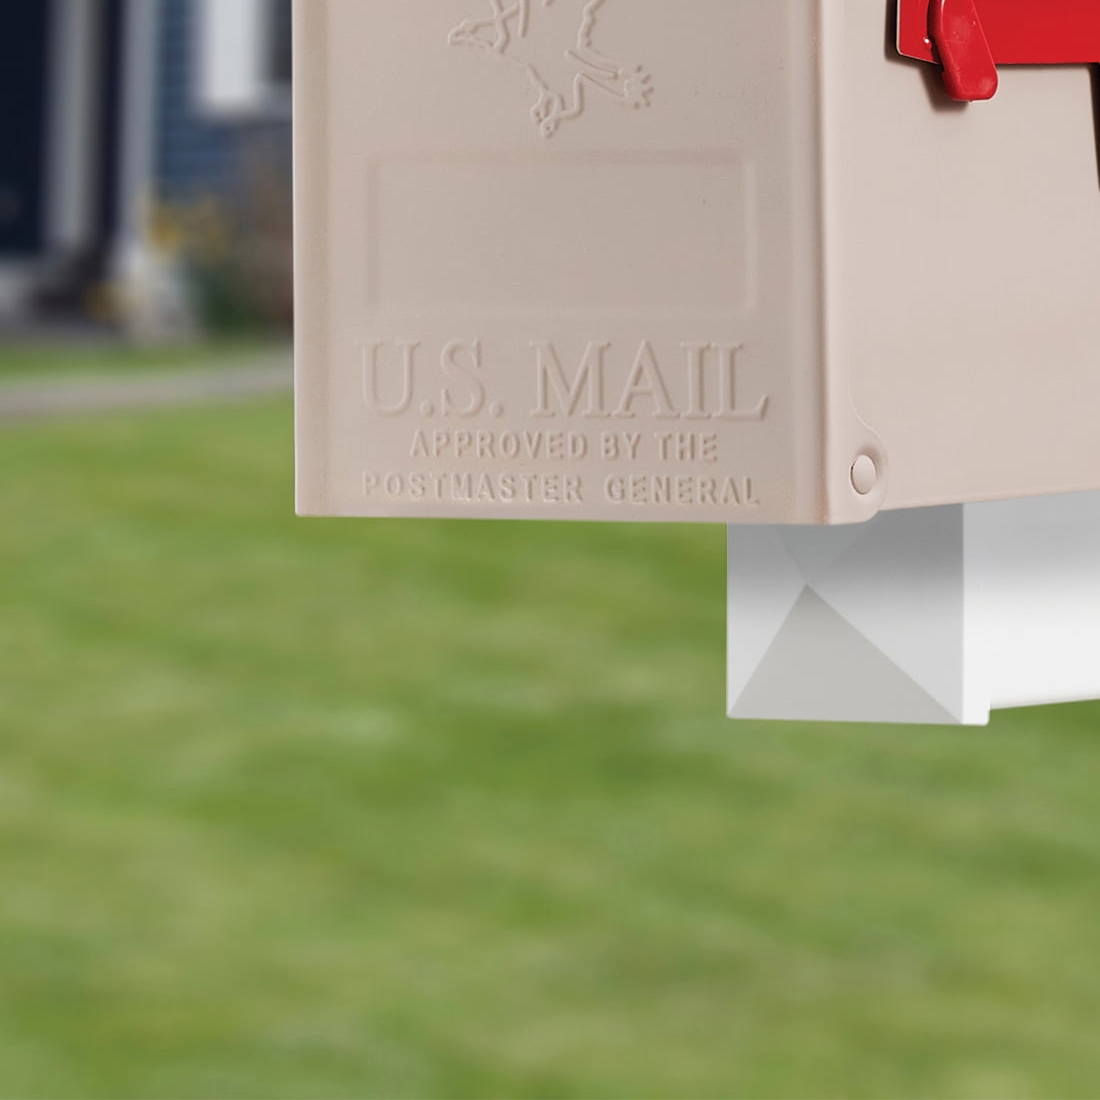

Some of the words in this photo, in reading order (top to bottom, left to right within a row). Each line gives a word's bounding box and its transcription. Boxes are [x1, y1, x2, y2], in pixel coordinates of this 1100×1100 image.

[358, 337, 504, 418] U.S.
[529, 338, 770, 421] MAIL
[409, 429, 588, 461] APPROVED
[600, 432, 642, 462] BY
[653, 432, 719, 463] THE
[361, 470, 584, 502] POSTMASTER
[604, 474, 760, 506] GENERAL
